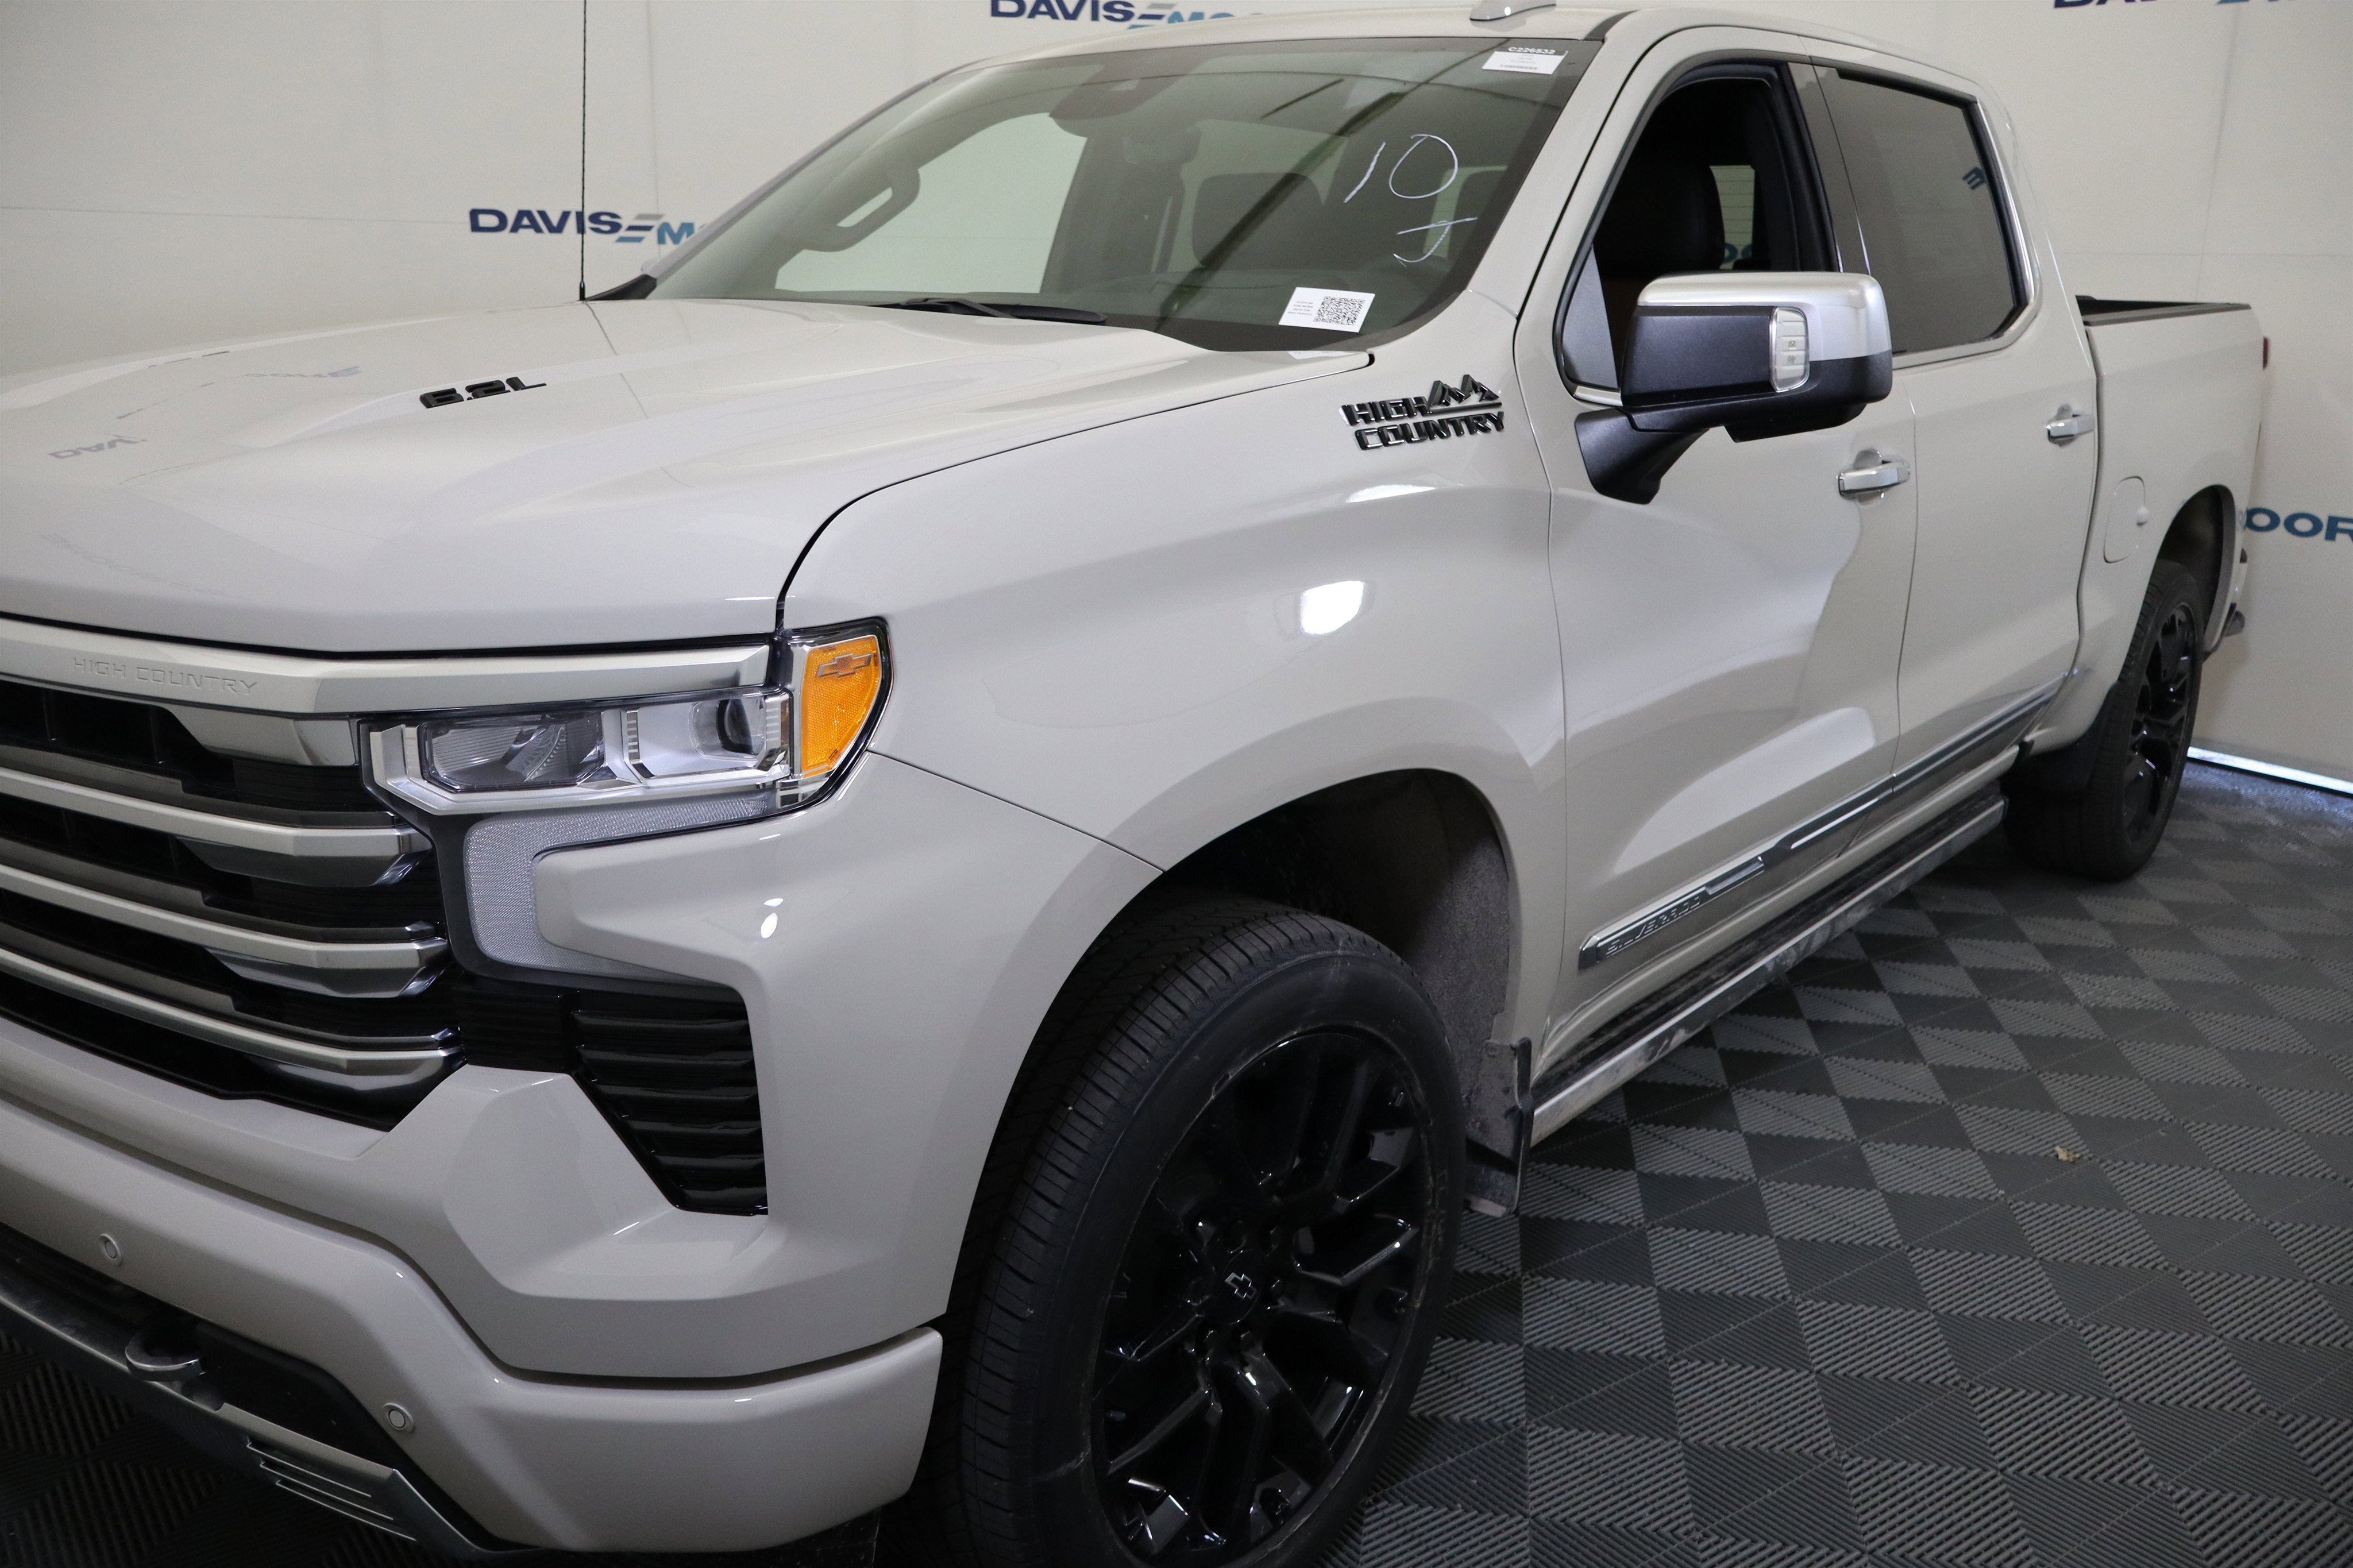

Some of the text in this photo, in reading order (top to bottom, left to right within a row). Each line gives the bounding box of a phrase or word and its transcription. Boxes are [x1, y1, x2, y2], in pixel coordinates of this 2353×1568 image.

[1344, 134, 1459, 203] 10
[469, 208, 622, 235] DAVIS
[1339, 396, 1432, 426] HIGH
[1355, 411, 1505, 450] COUNTRY
[73, 658, 259, 694] HIGH COUNTRY
